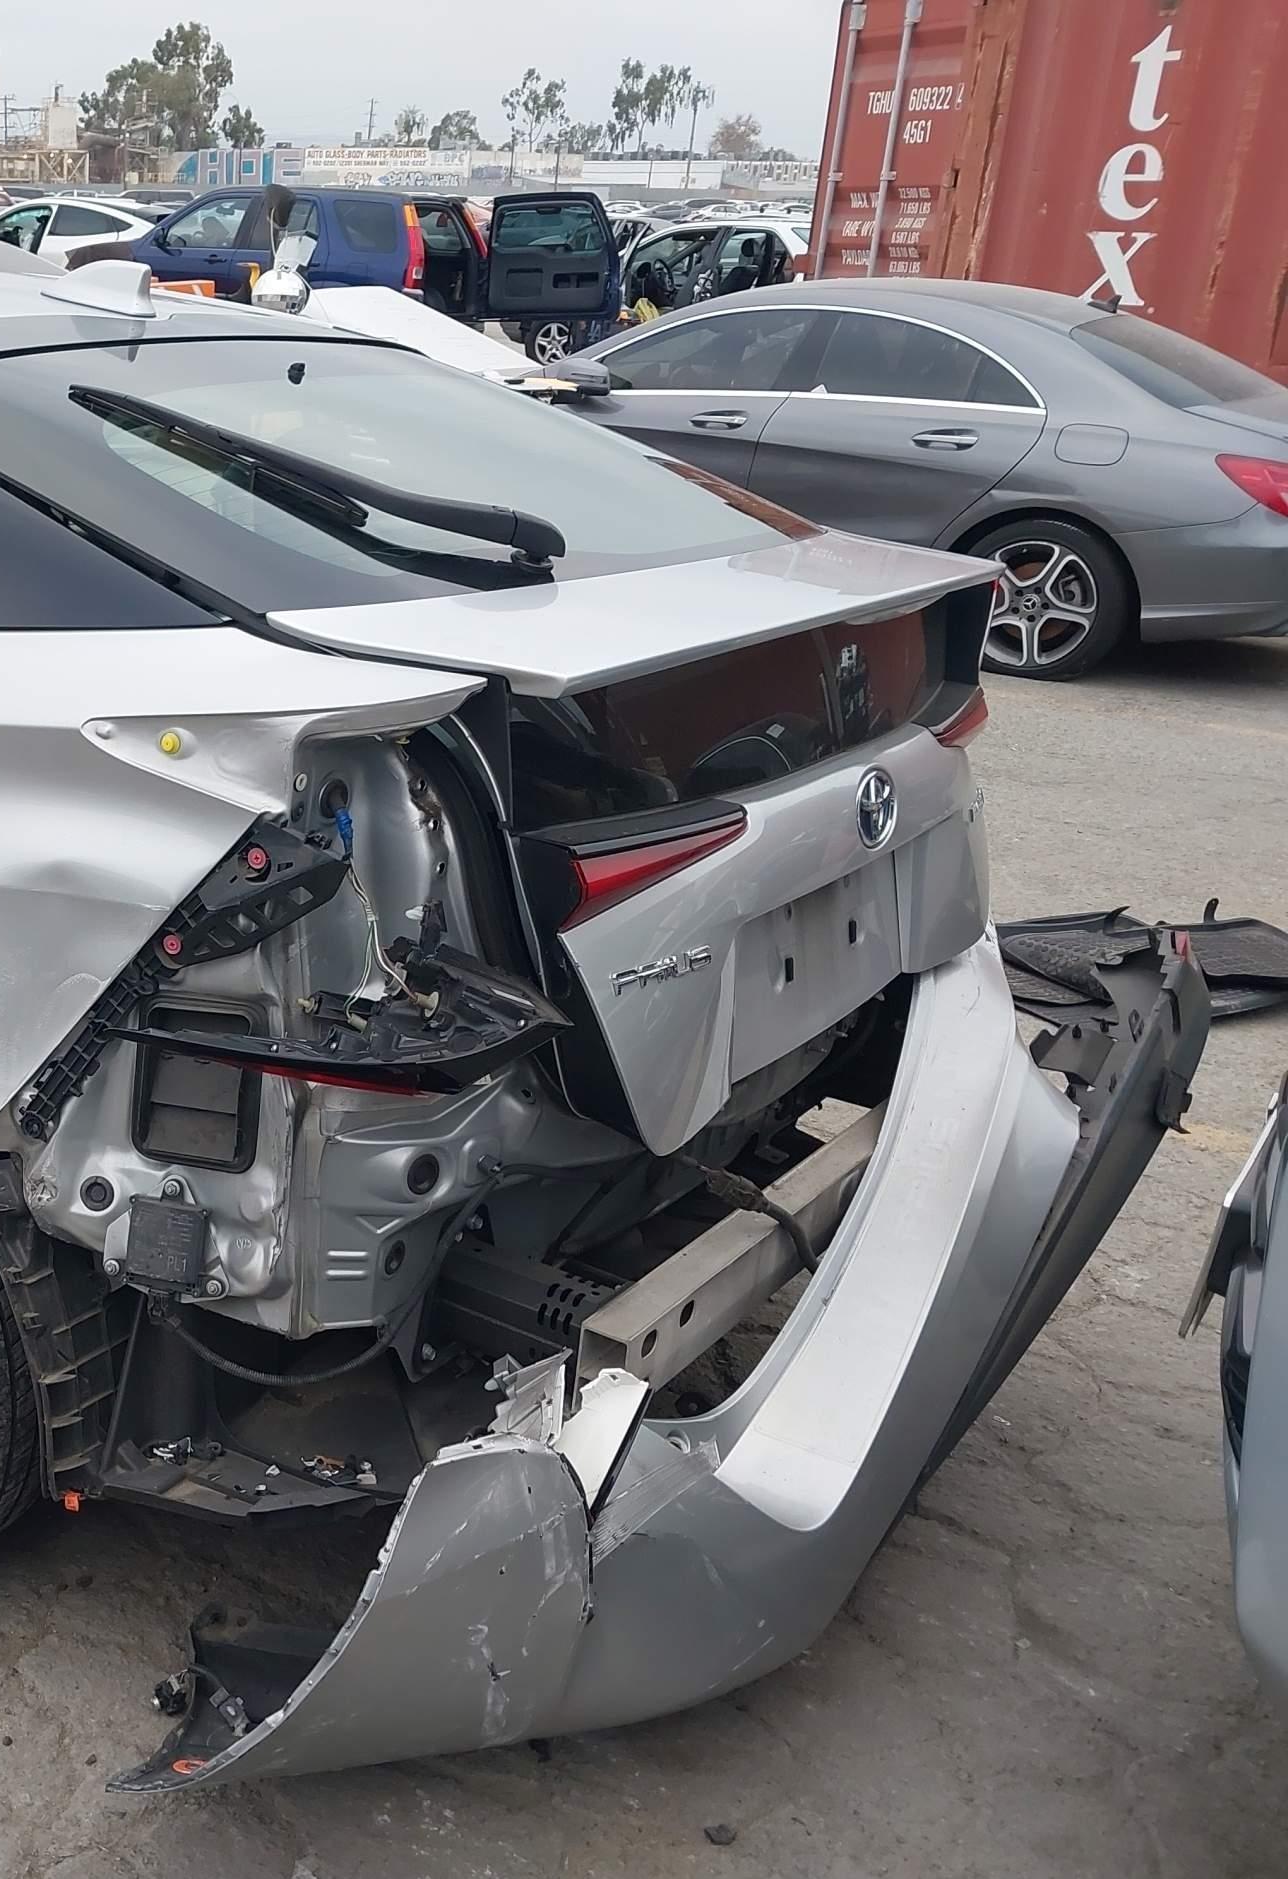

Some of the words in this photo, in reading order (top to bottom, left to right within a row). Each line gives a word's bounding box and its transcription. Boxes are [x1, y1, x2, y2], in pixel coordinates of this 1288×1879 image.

[908, 86, 953, 111] 609322
[903, 120, 932, 144] 45G1
[307, 150, 324, 159] AUTO
